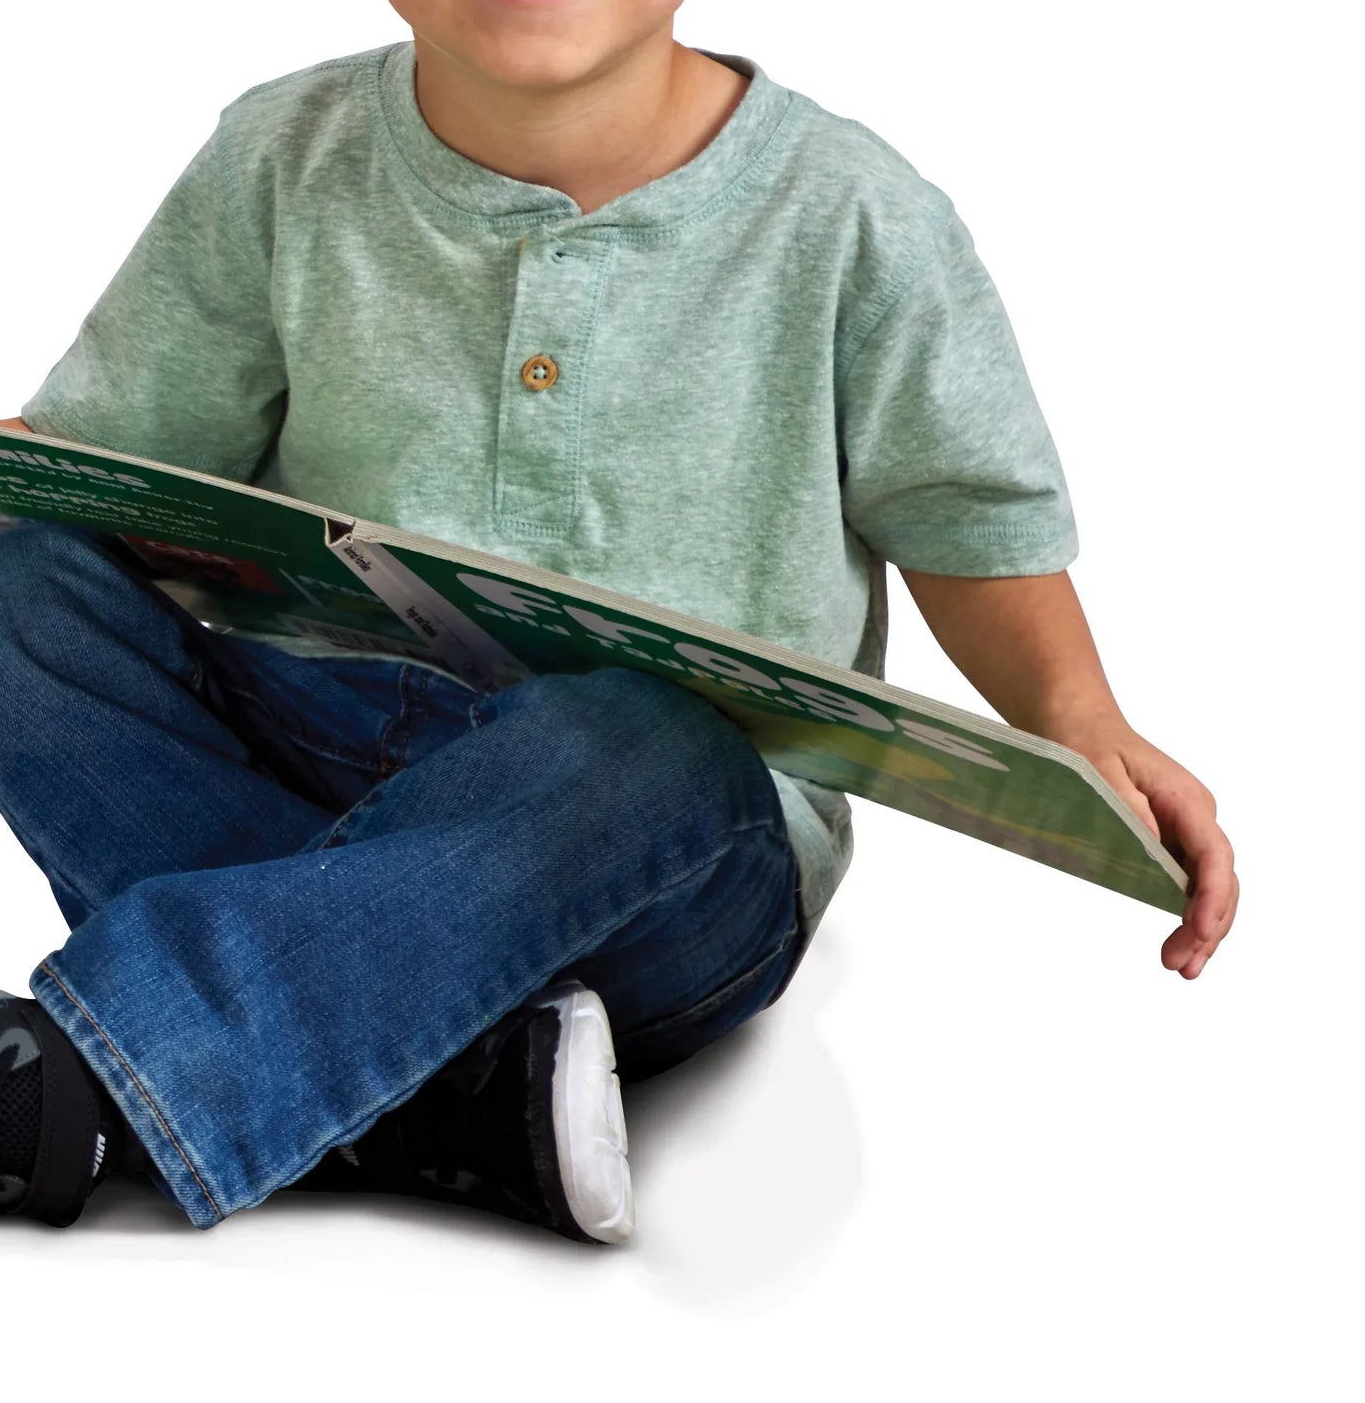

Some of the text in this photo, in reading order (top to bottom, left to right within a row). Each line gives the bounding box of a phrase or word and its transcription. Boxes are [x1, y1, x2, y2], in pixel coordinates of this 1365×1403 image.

[13, 484, 139, 516] hopping
[455, 572, 1012, 773] Frogs
[474, 602, 839, 723] and Tadpoles
